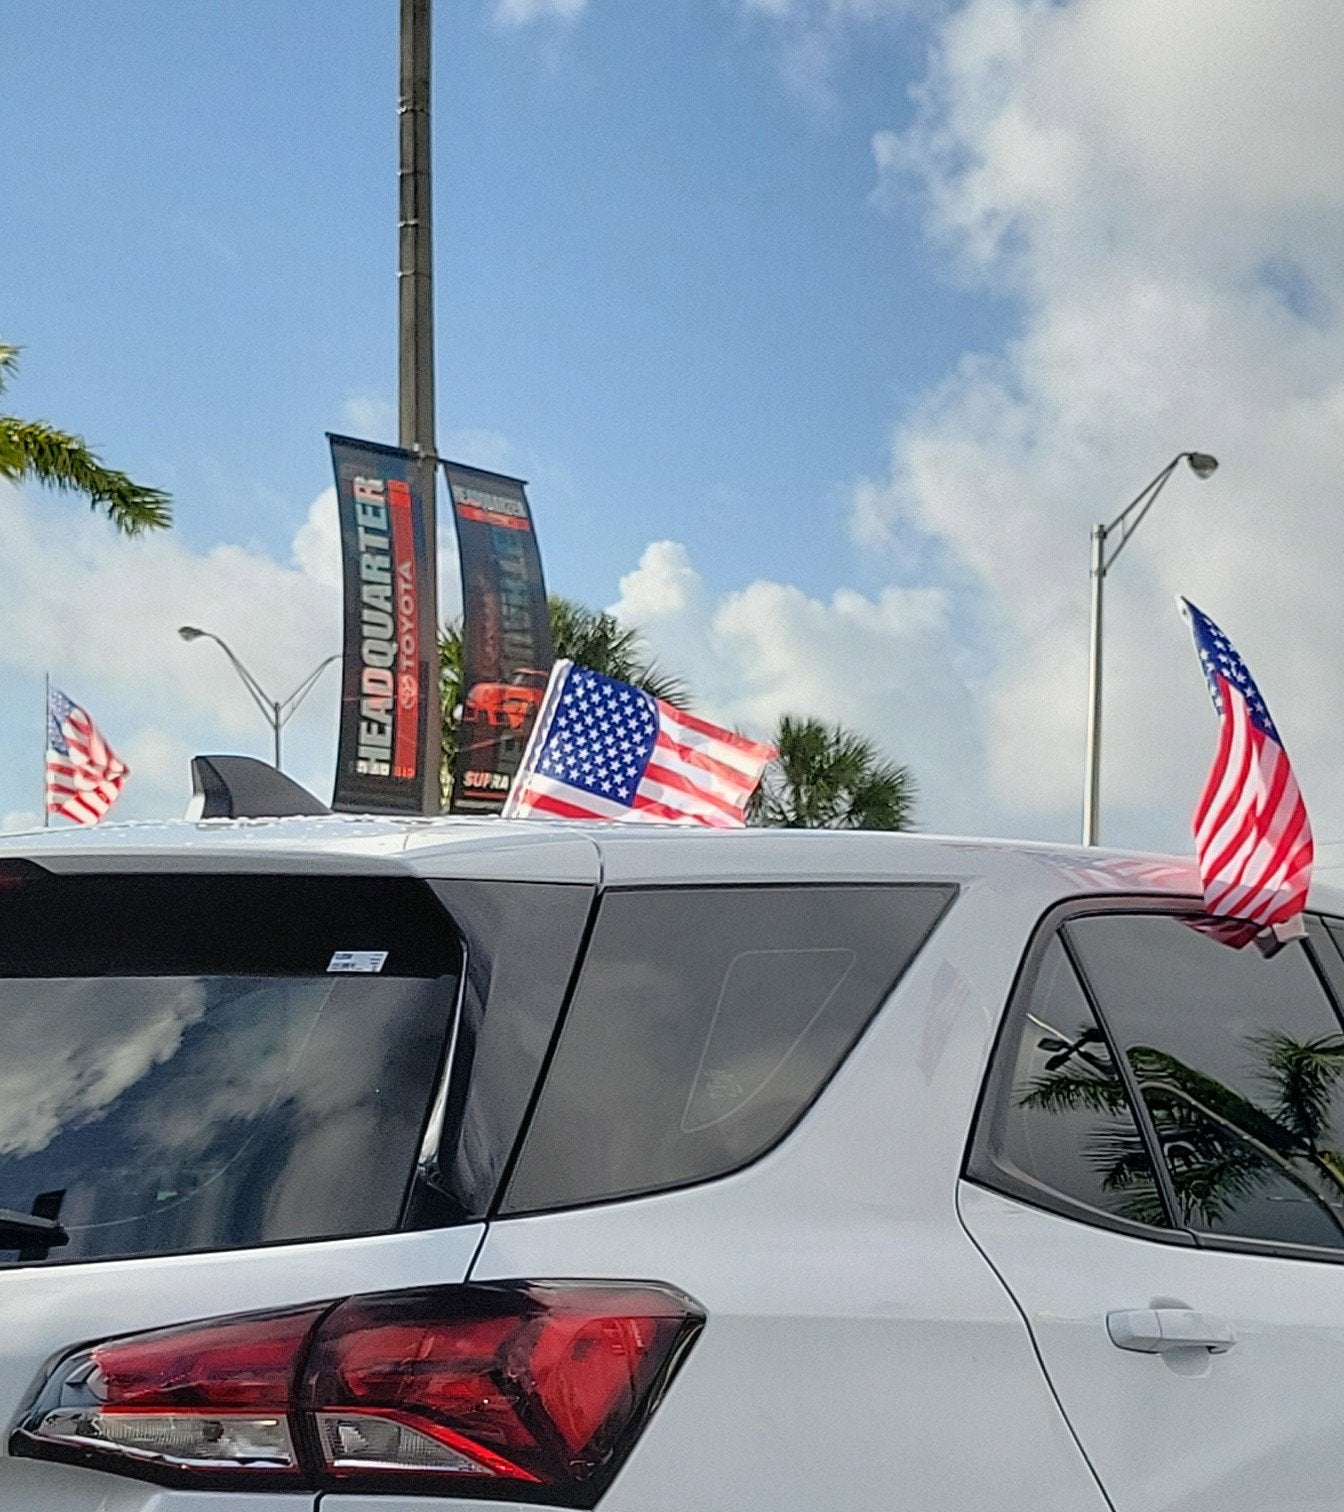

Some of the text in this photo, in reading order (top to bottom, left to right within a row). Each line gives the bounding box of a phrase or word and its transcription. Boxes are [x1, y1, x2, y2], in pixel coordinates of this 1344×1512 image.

[353, 476, 398, 777] HEADQUARTER
[397, 561, 416, 672] TOYOTA
[463, 770, 510, 791] SUPRA
